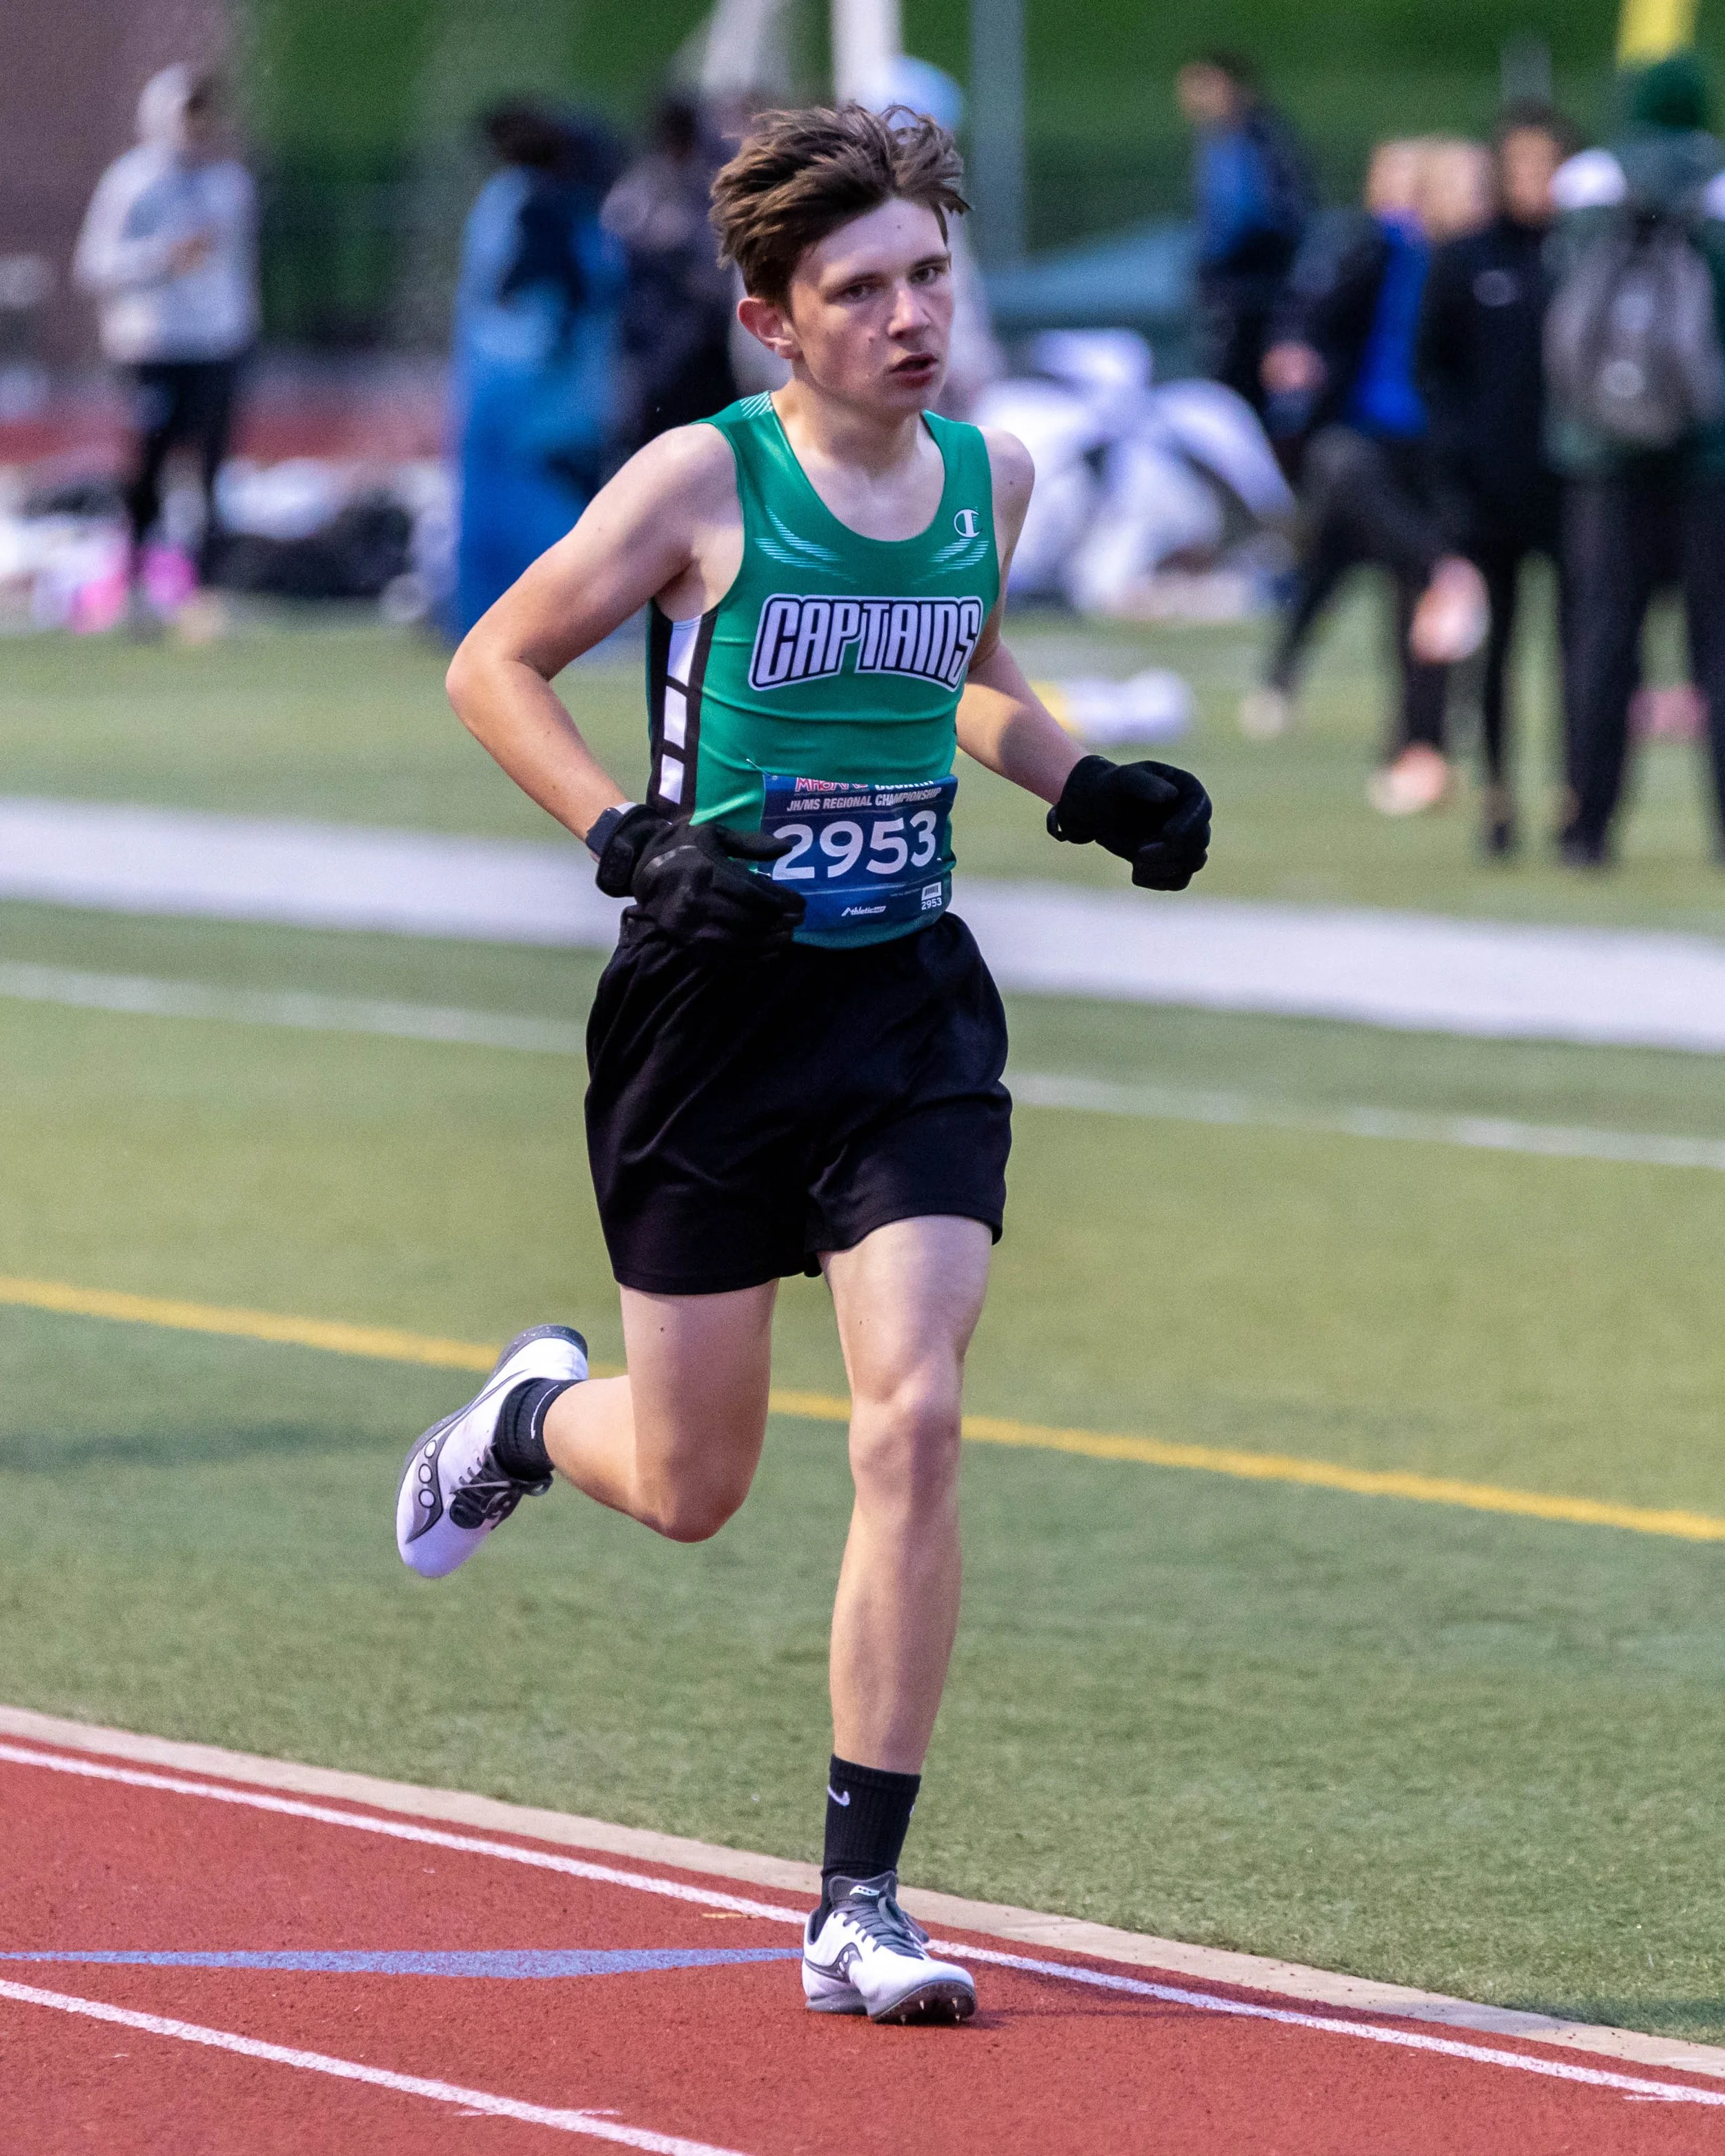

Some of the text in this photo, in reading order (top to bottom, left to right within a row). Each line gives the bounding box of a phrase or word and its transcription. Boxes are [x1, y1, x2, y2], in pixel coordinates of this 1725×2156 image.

[748, 593, 983, 692] CAPTAINS
[787, 798, 821, 811] JH/MS
[822, 795, 872, 809] REGIONAL
[875, 787, 942, 806] CHAMPIONSHIP
[771, 810, 937, 880] 2953
[921, 897, 942, 911] 2953
